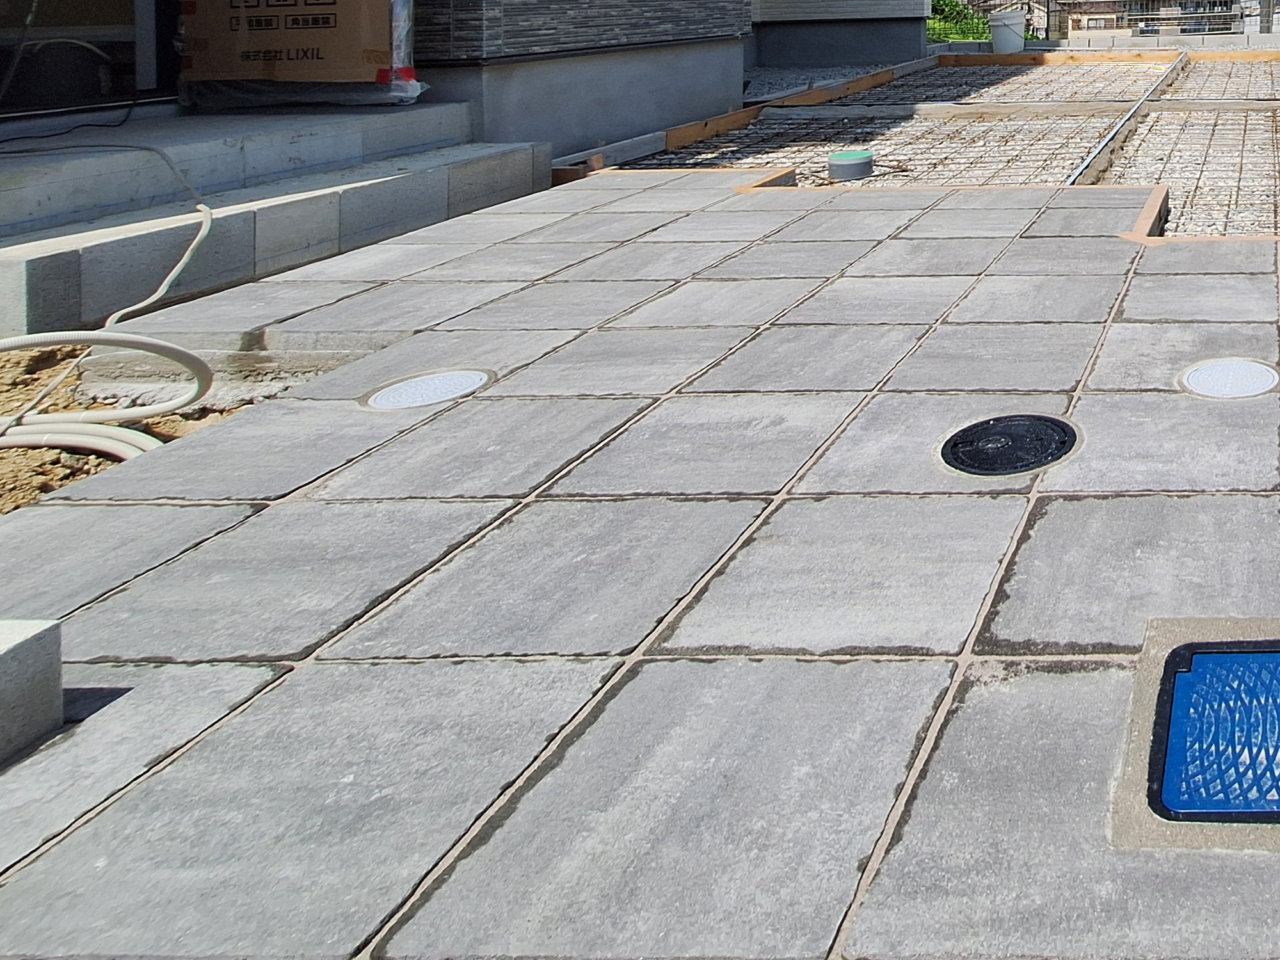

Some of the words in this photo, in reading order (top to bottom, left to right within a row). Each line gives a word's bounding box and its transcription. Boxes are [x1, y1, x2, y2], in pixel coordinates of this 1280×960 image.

[240, 49, 283, 62] 株式会社
[287, 47, 325, 61] LIXIL
